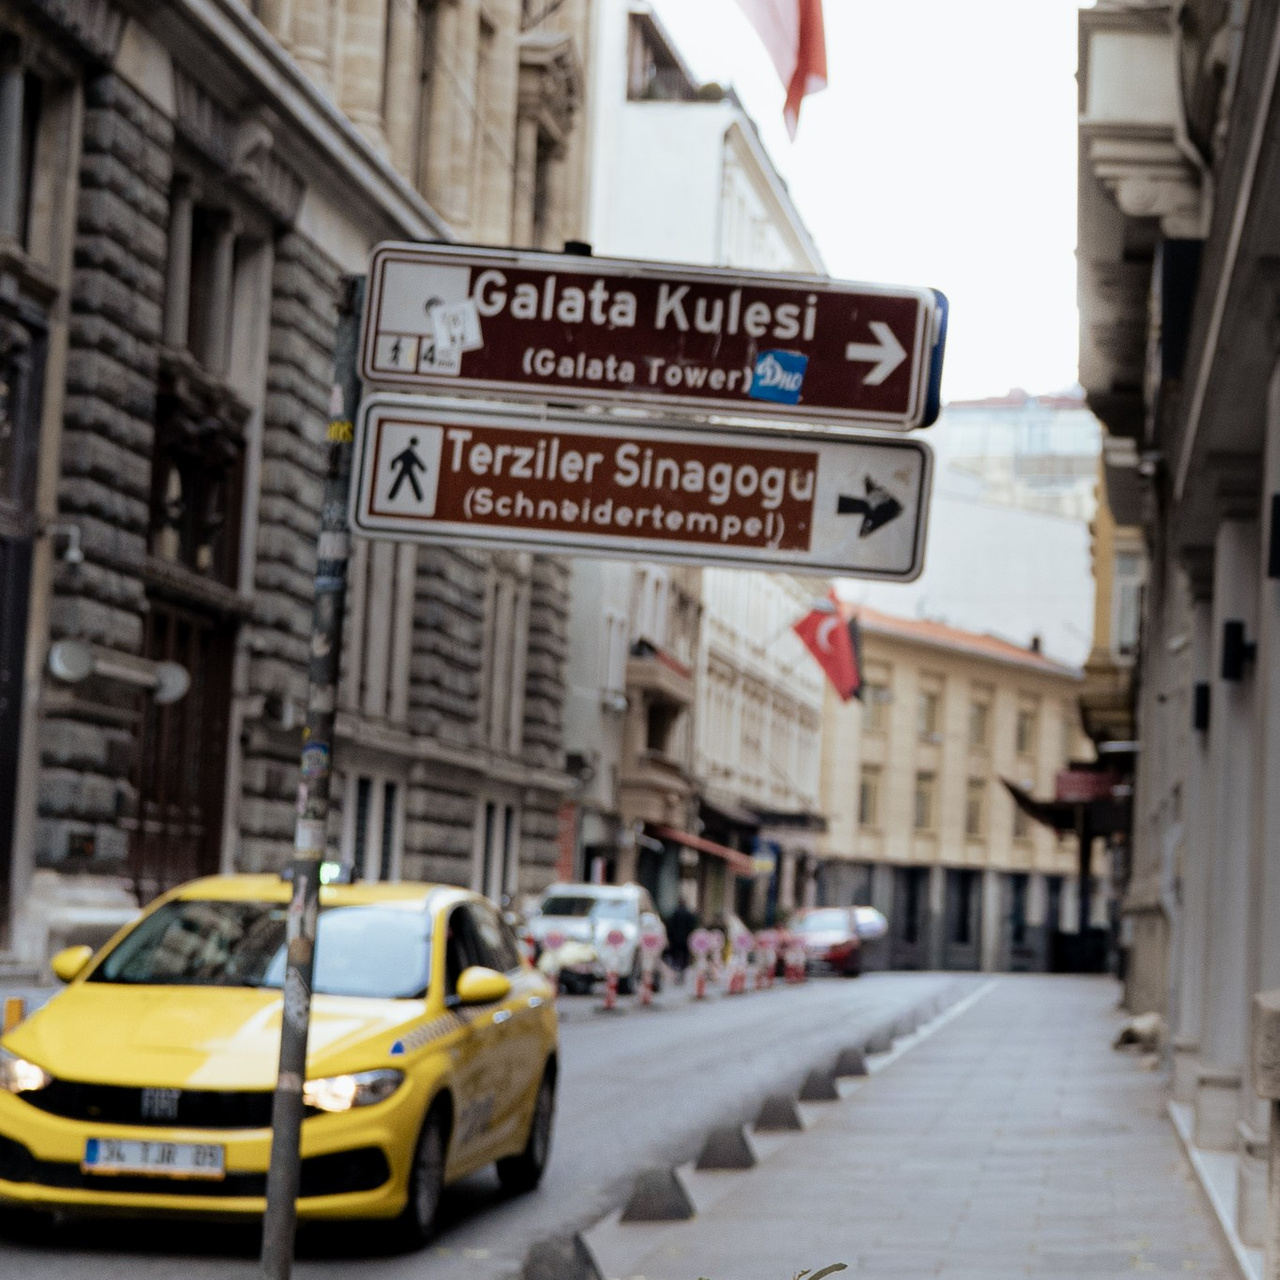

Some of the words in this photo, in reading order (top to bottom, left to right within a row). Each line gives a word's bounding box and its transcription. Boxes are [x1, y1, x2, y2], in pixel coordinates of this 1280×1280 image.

[473, 269, 638, 327] Galata
[655, 283, 818, 341] Kulesi
[522, 347, 636, 384] (Galata
[647, 356, 753, 394] Tower)
[447, 429, 604, 484] Terziler
[613, 442, 815, 510] Sinagogu
[463, 486, 785, 546] (Schneidertempel)
